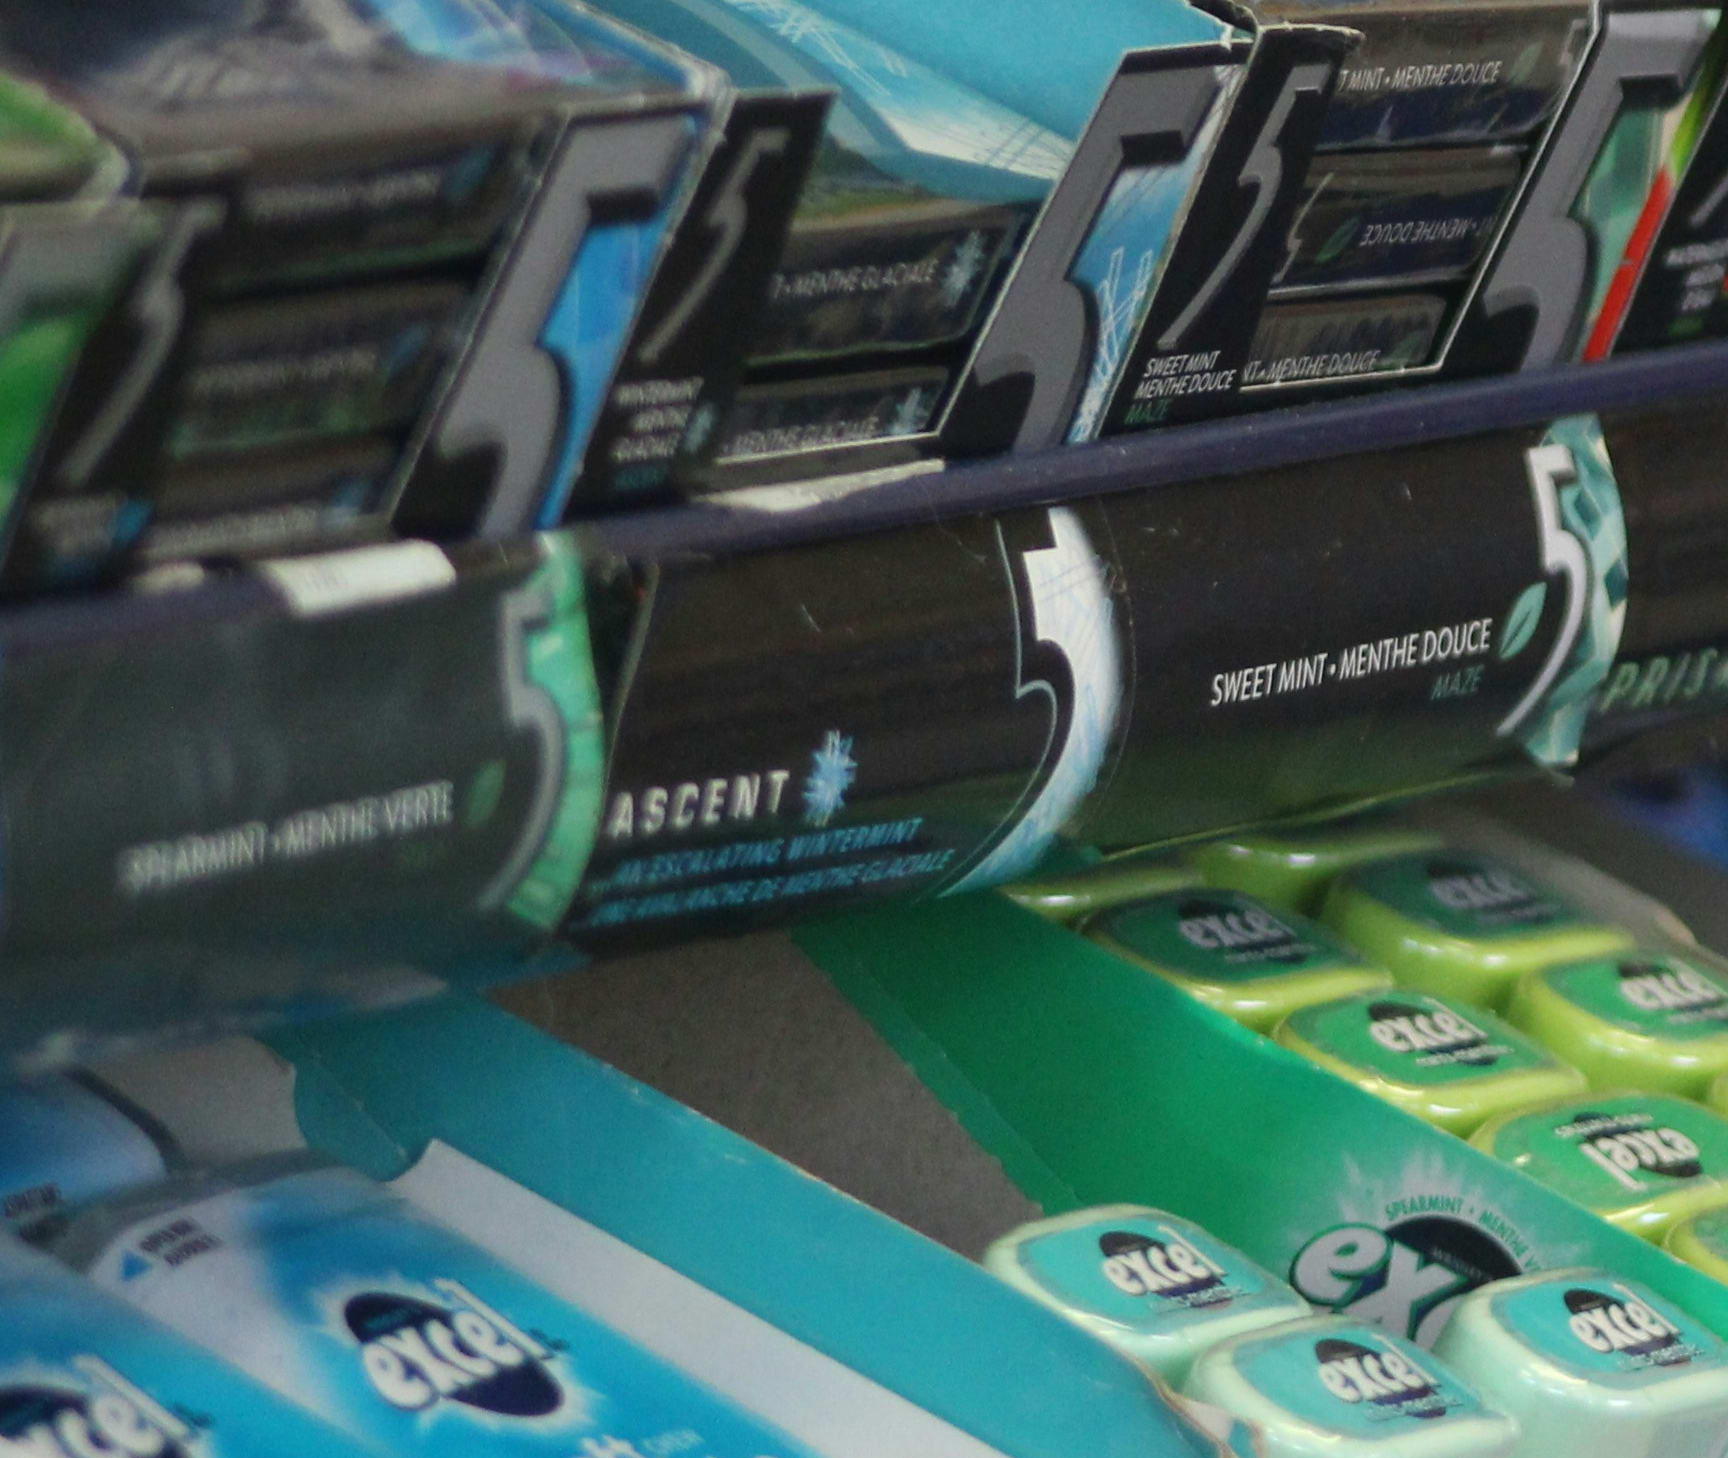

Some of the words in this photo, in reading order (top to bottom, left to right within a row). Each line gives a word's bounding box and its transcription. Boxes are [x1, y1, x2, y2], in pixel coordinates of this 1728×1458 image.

[1392, 62, 1450, 90] MENTHE
[1451, 59, 1503, 86] DOUCE
[1134, 373, 1194, 400] MENTHE
[1191, 368, 1236, 395] DOUCE
[1144, 354, 1187, 379] SWEET
[1185, 350, 1221, 374] MINT
[1325, 349, 1382, 376] DOUCE
[1211, 660, 1276, 708] SWEET
[1277, 652, 1328, 696] MINT
[1339, 628, 1421, 680] MENTHE
[1422, 616, 1493, 664] DOUCE
[1430, 664, 1484, 702] MAZE
[604, 768, 791, 841] ASCENT
[1618, 955, 1728, 1011] excel
[1368, 996, 1488, 1054] excel
[1103, 1224, 1228, 1298] excel
[361, 1278, 560, 1411] excel
[1569, 1282, 1683, 1353] excel
[1318, 1332, 1440, 1402] excel
